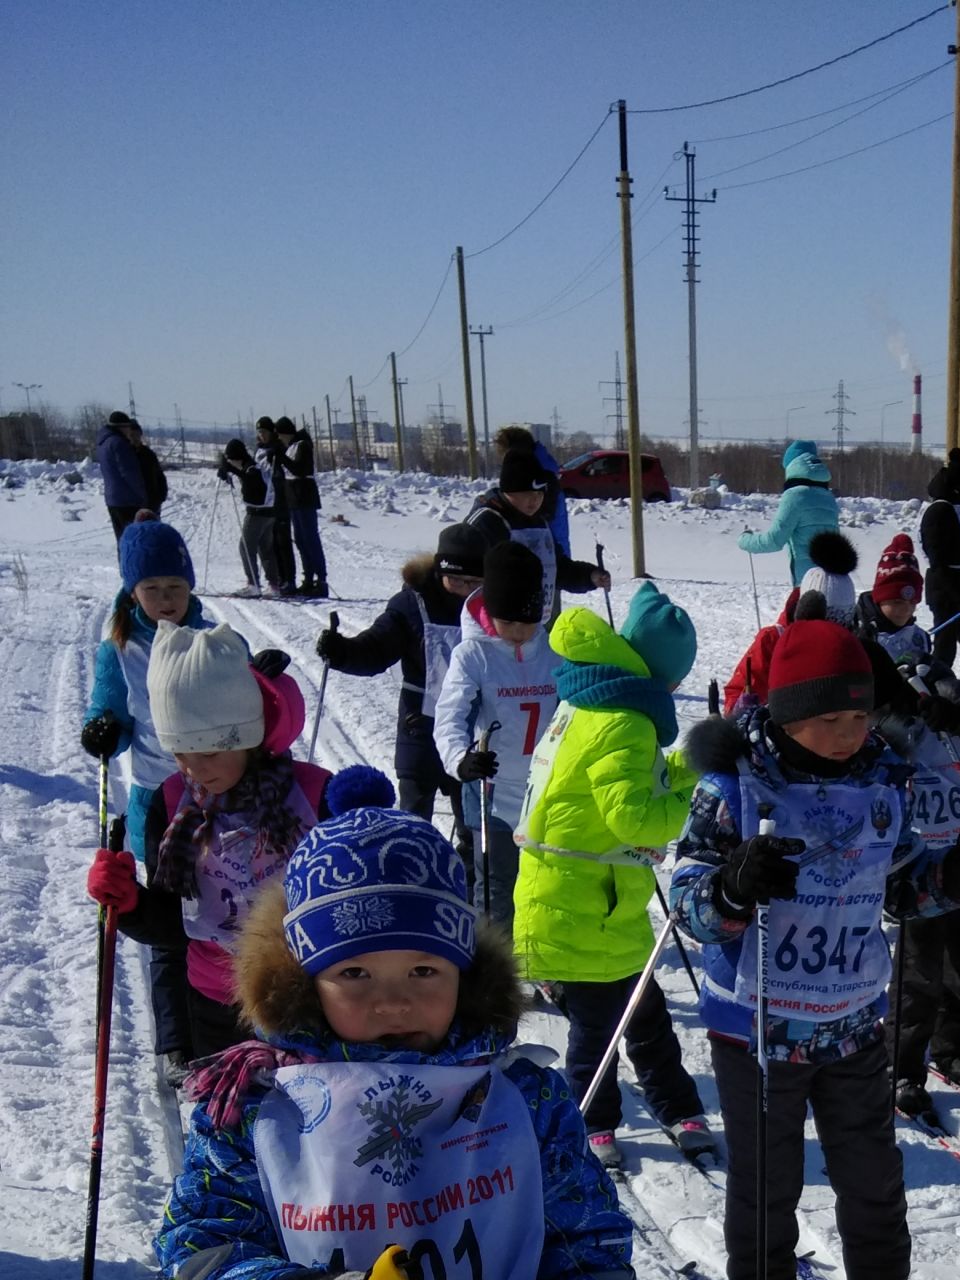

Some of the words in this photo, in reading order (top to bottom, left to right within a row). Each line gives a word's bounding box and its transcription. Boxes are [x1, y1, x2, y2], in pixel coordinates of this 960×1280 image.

[519, 702, 541, 756] 7
[806, 868, 857, 888] РОССИИ
[793, 892, 883, 909] портмастер
[774, 923, 872, 976] 6347
[804, 1002, 849, 1014] РОССИИ
[363, 1074, 432, 1103] ЛЫЖНЯ
[386, 1182, 465, 1229] РОССИИ
[466, 1164, 514, 1206] 2011
